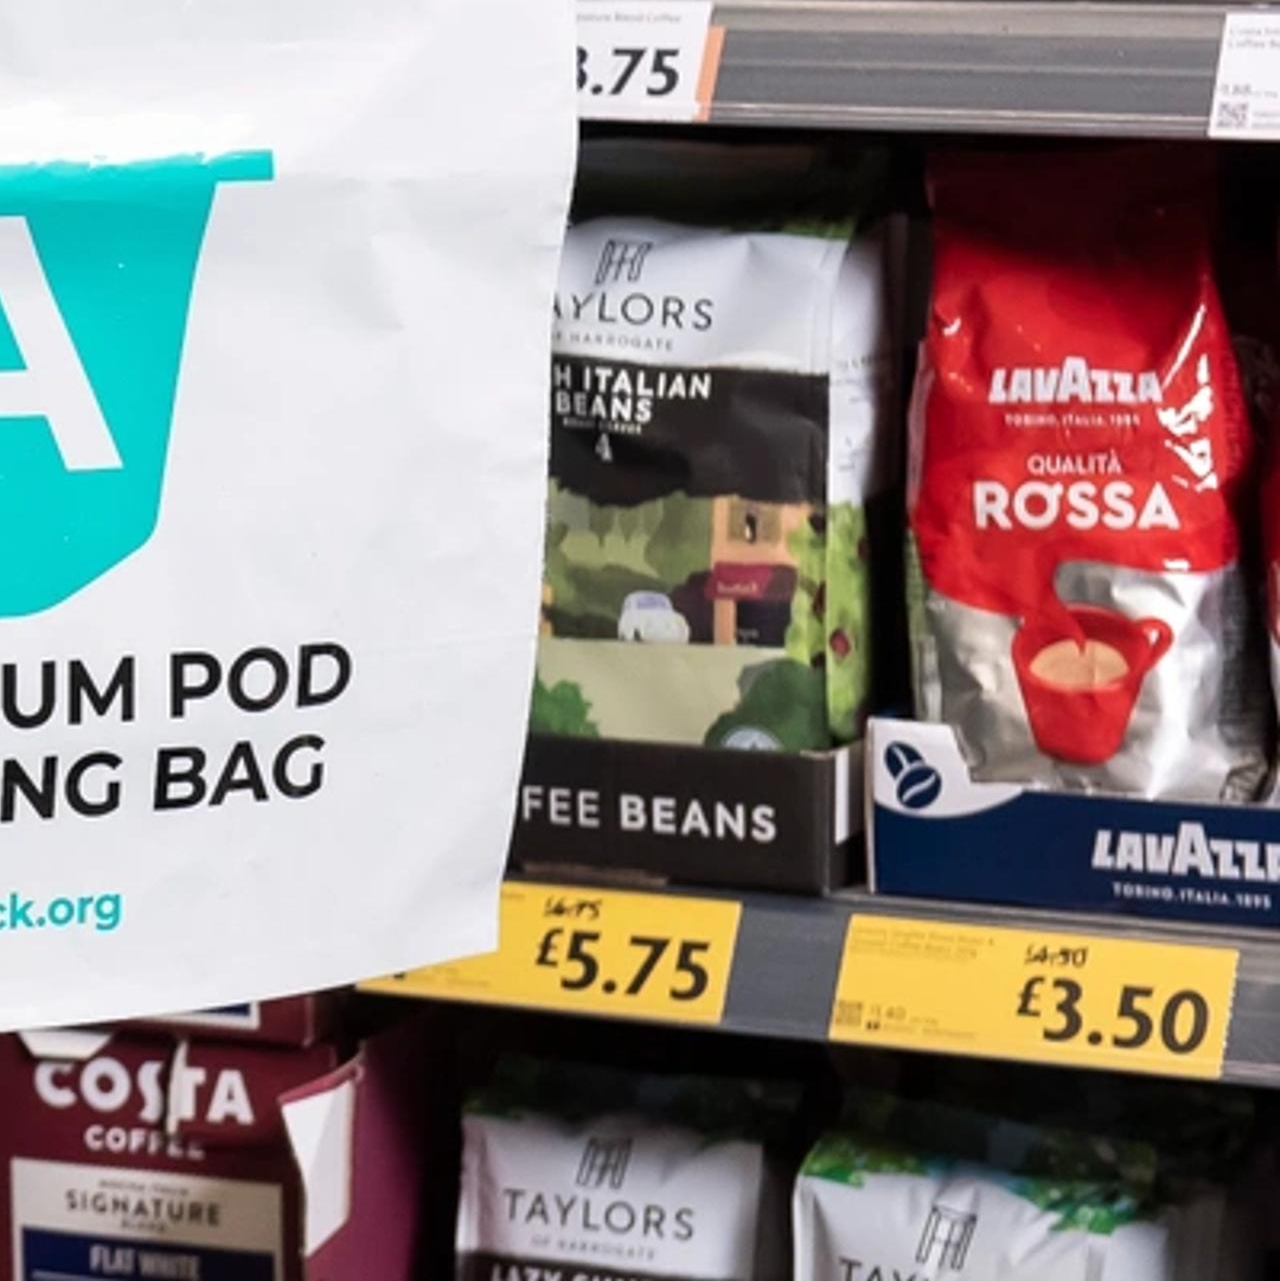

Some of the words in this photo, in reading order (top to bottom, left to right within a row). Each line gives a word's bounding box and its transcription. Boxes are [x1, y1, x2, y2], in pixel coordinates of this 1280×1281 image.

[571, 332, 673, 351] HARROGATE
[584, 366, 712, 400] ITALIAN
[988, 357, 1162, 403] LAVAZZA
[555, 390, 653, 423] BEANS
[1027, 449, 1121, 474] QUALITÀ
[169, 642, 353, 718] POD
[152, 734, 326, 811] BAG
[620, 793, 777, 843] BEANS
[536, 928, 710, 1001] £5.75
[1018, 975, 1208, 1054] £3.50
[35, 1056, 254, 1125] COSTA
[84, 1125, 206, 1160] COFFEE
[66, 1189, 220, 1226] SIGNATURE
[504, 1188, 695, 1241] TAYLORS
